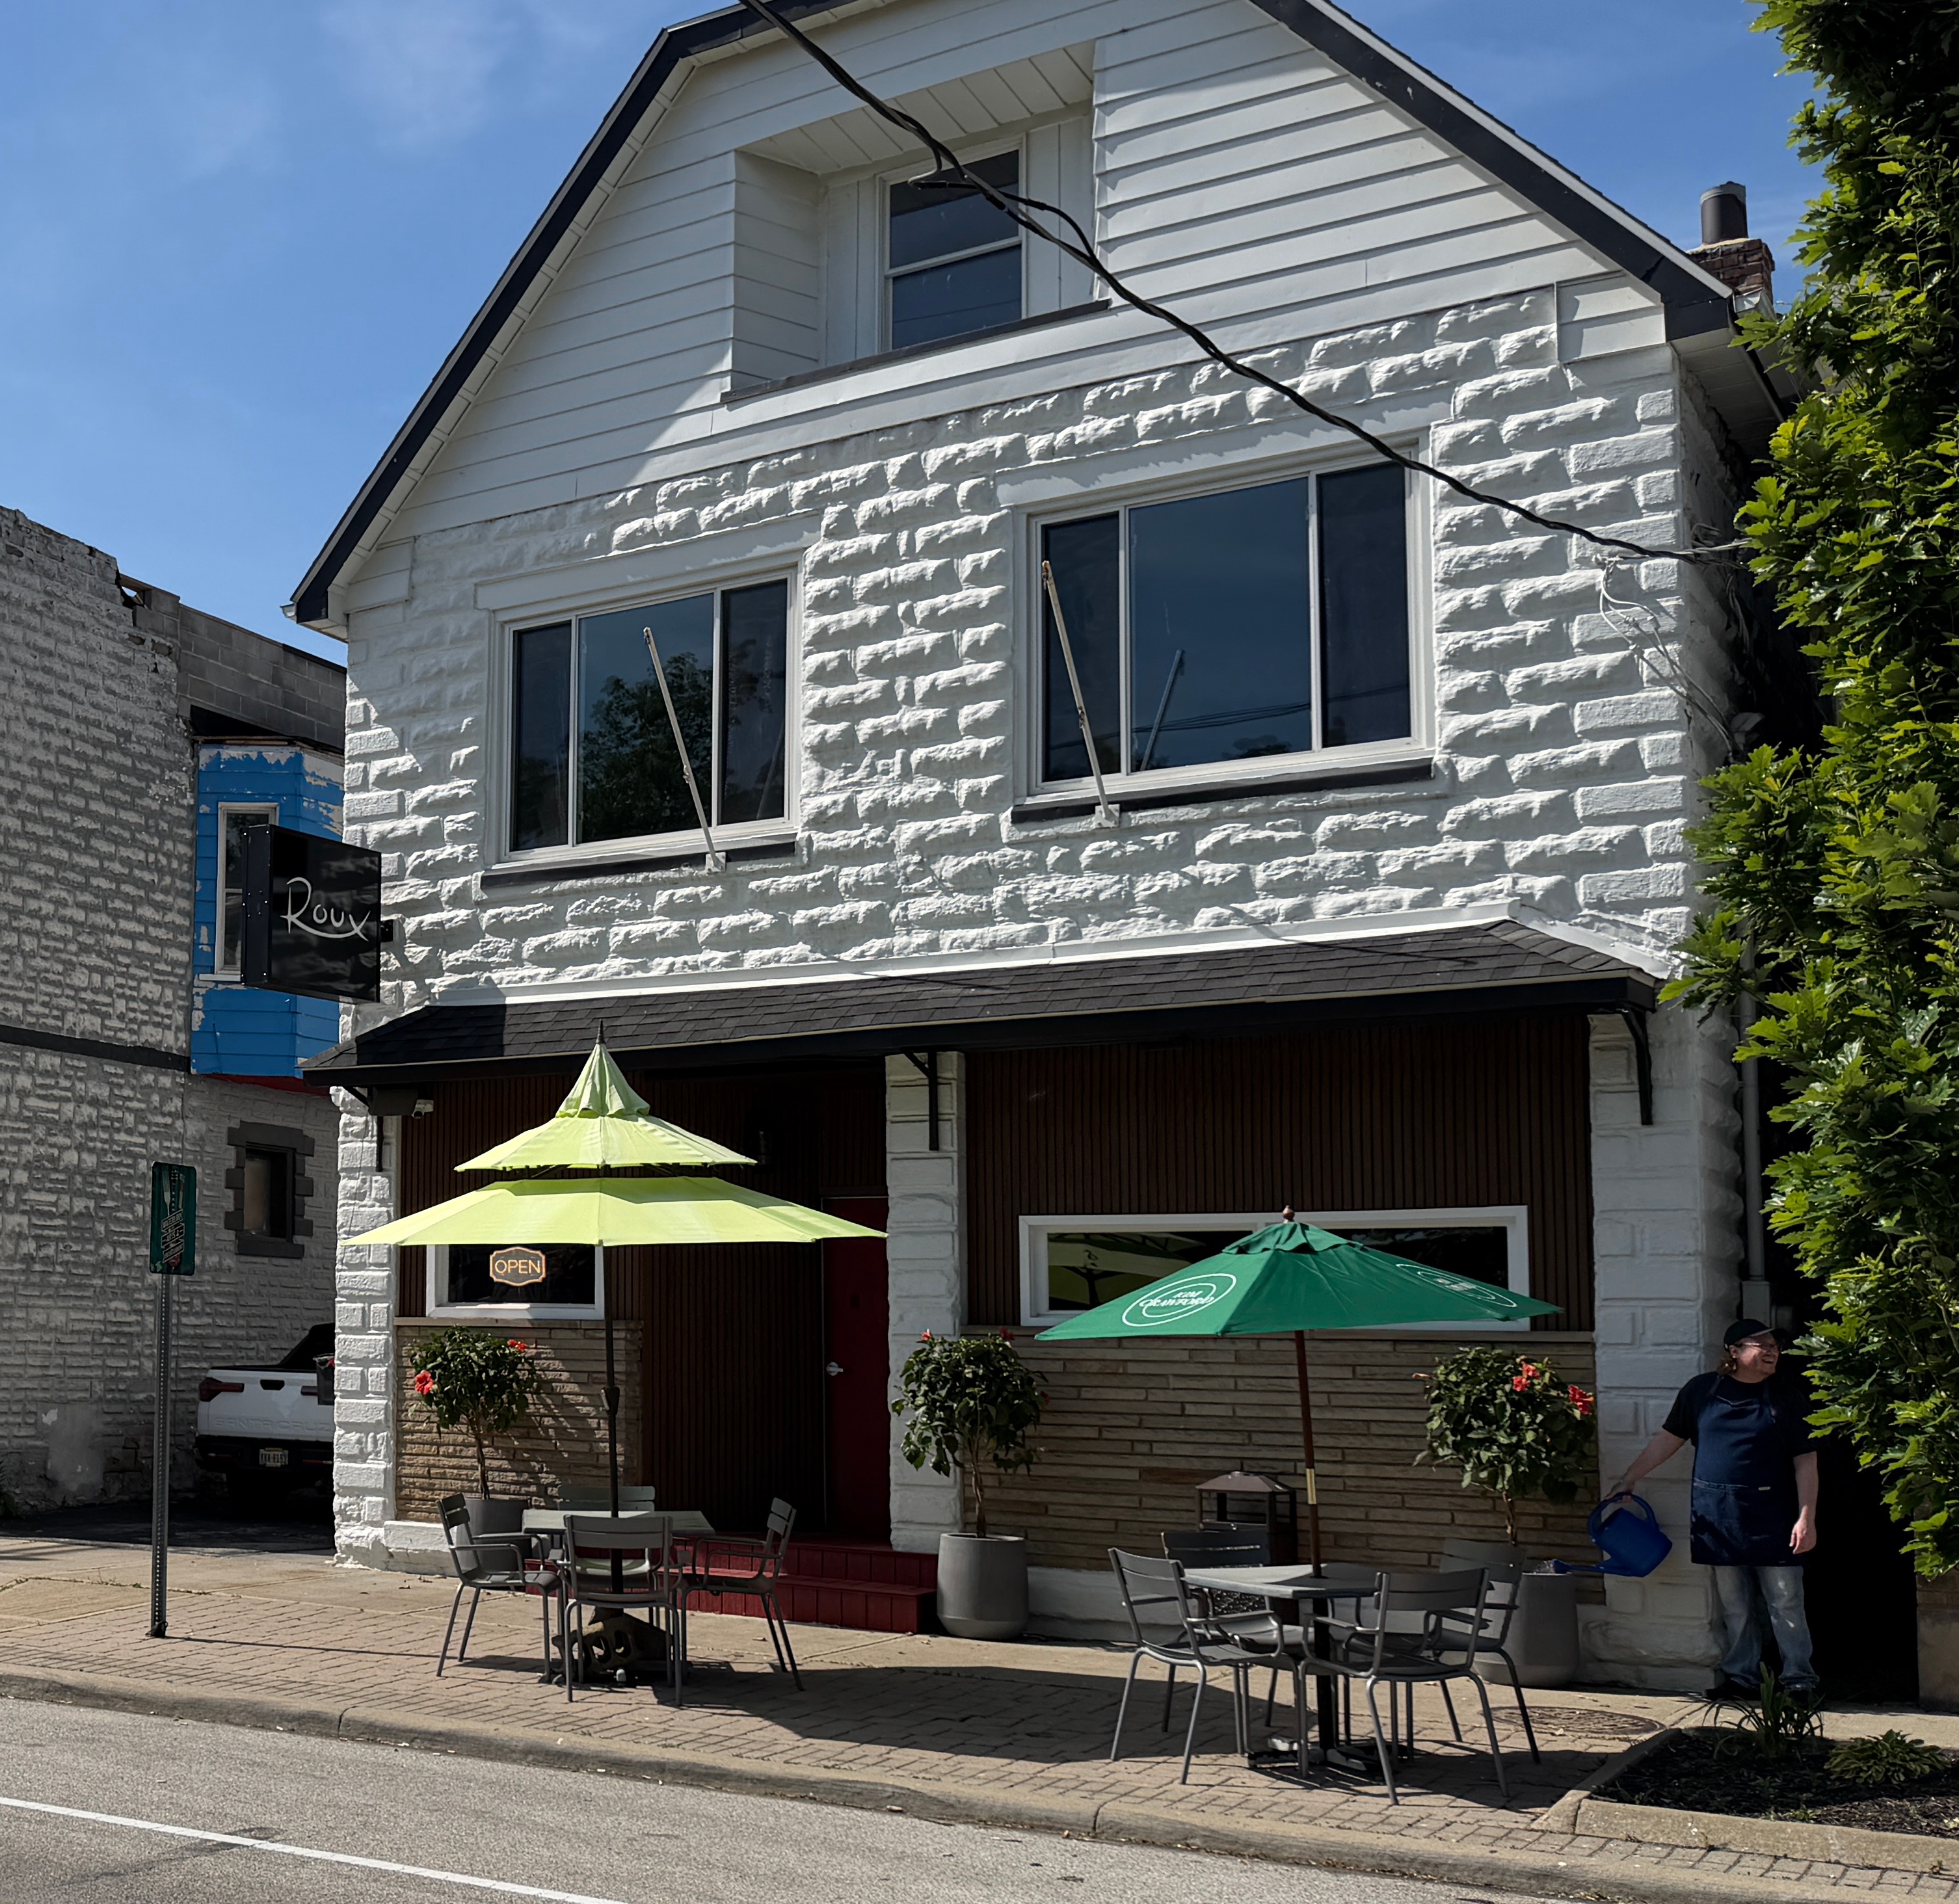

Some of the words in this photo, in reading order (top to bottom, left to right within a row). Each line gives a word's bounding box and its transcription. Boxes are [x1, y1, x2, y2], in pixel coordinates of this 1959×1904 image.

[494, 1260, 540, 1273] OPEN
[215, 1417, 273, 1429] SANTA
[278, 1420, 332, 1431] CRUZ
